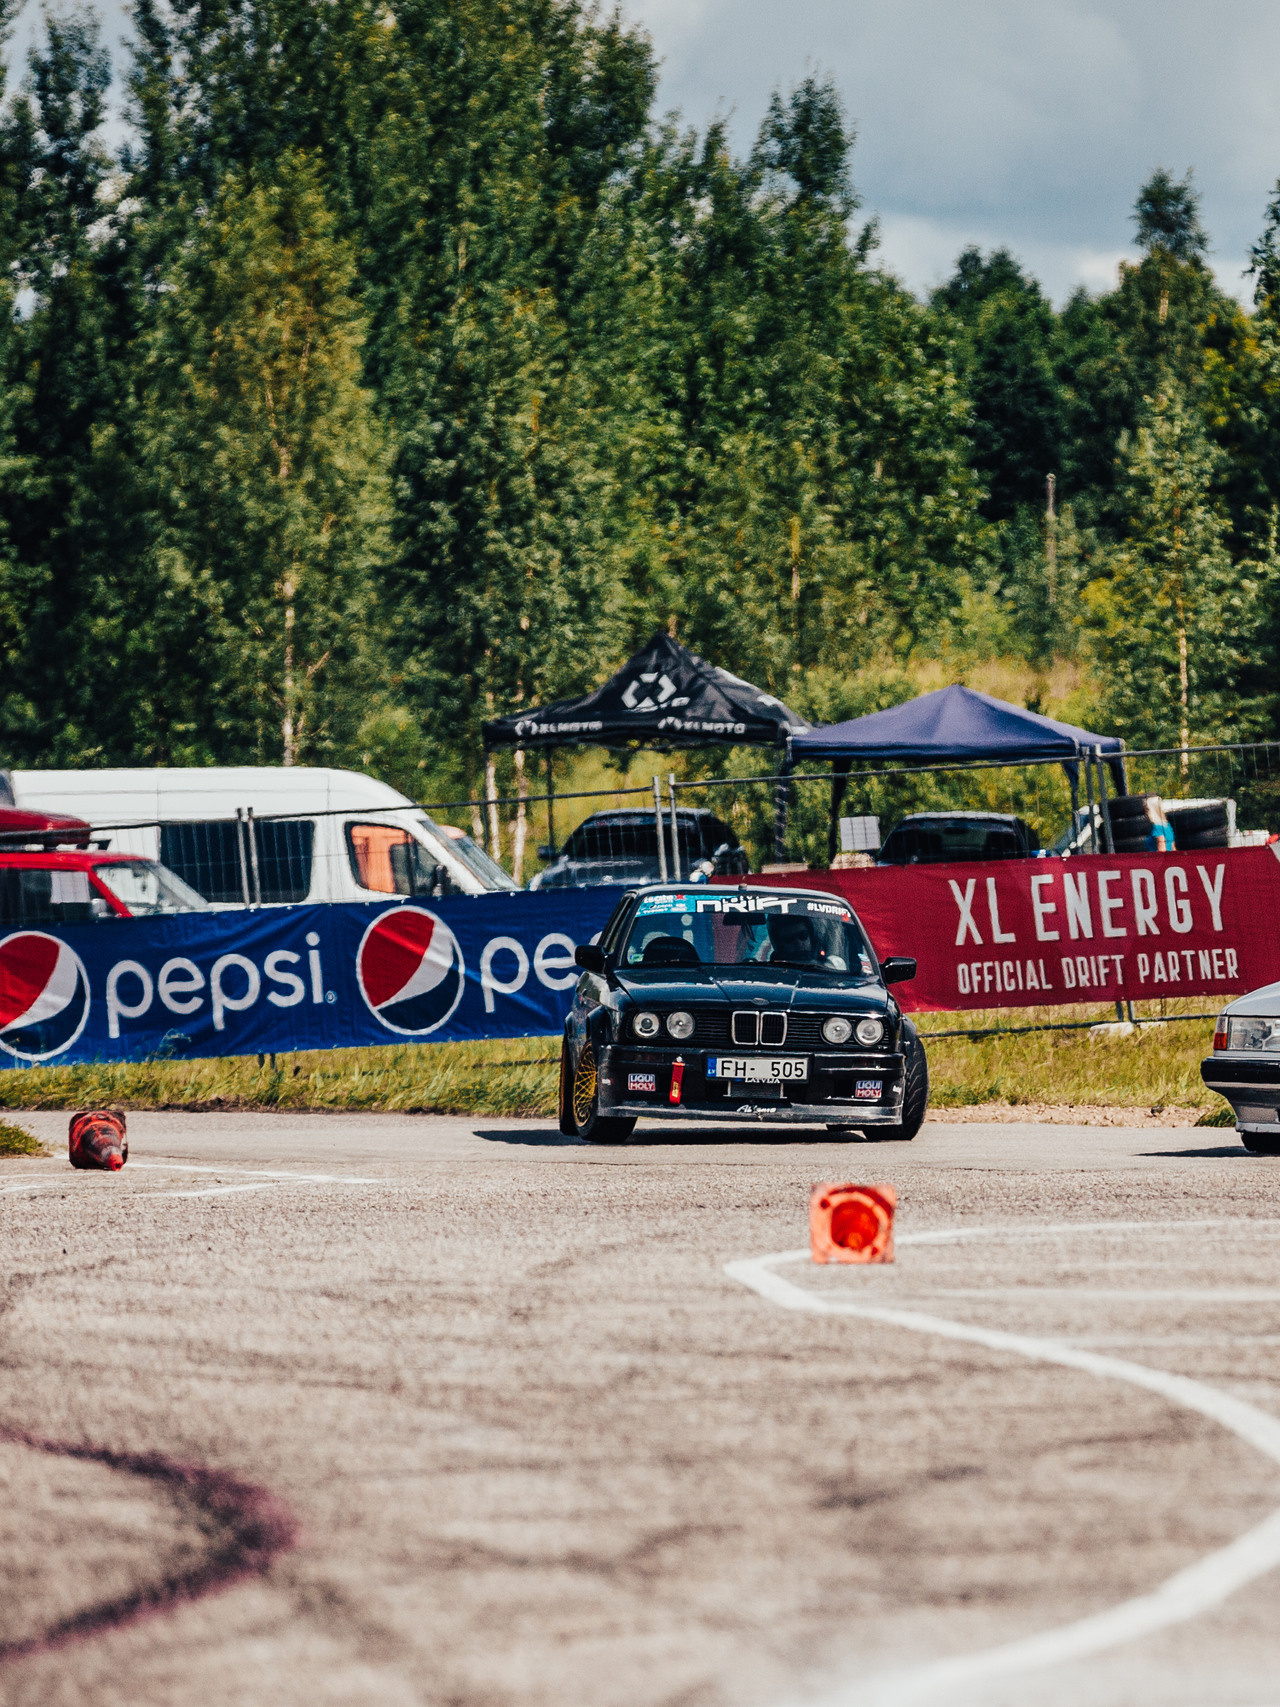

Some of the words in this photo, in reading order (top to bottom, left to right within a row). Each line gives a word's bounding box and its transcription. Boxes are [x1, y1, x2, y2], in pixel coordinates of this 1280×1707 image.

[696, 896, 798, 914] DRIFT
[948, 876, 1016, 945] XL
[1031, 863, 1226, 942] ENERGY
[957, 957, 1053, 995] OFFICIAL
[1062, 953, 1124, 988] DRIFT
[1137, 948, 1240, 983] PARTNER
[106, 931, 325, 1039] pepsi
[629, 1074, 655, 1082] LIQUI
[771, 1061, 805, 1078] 505
[629, 1082, 655, 1090] MOLY
[856, 1089, 881, 1097] MOLY
[857, 1081, 882, 1089] LIQUI
